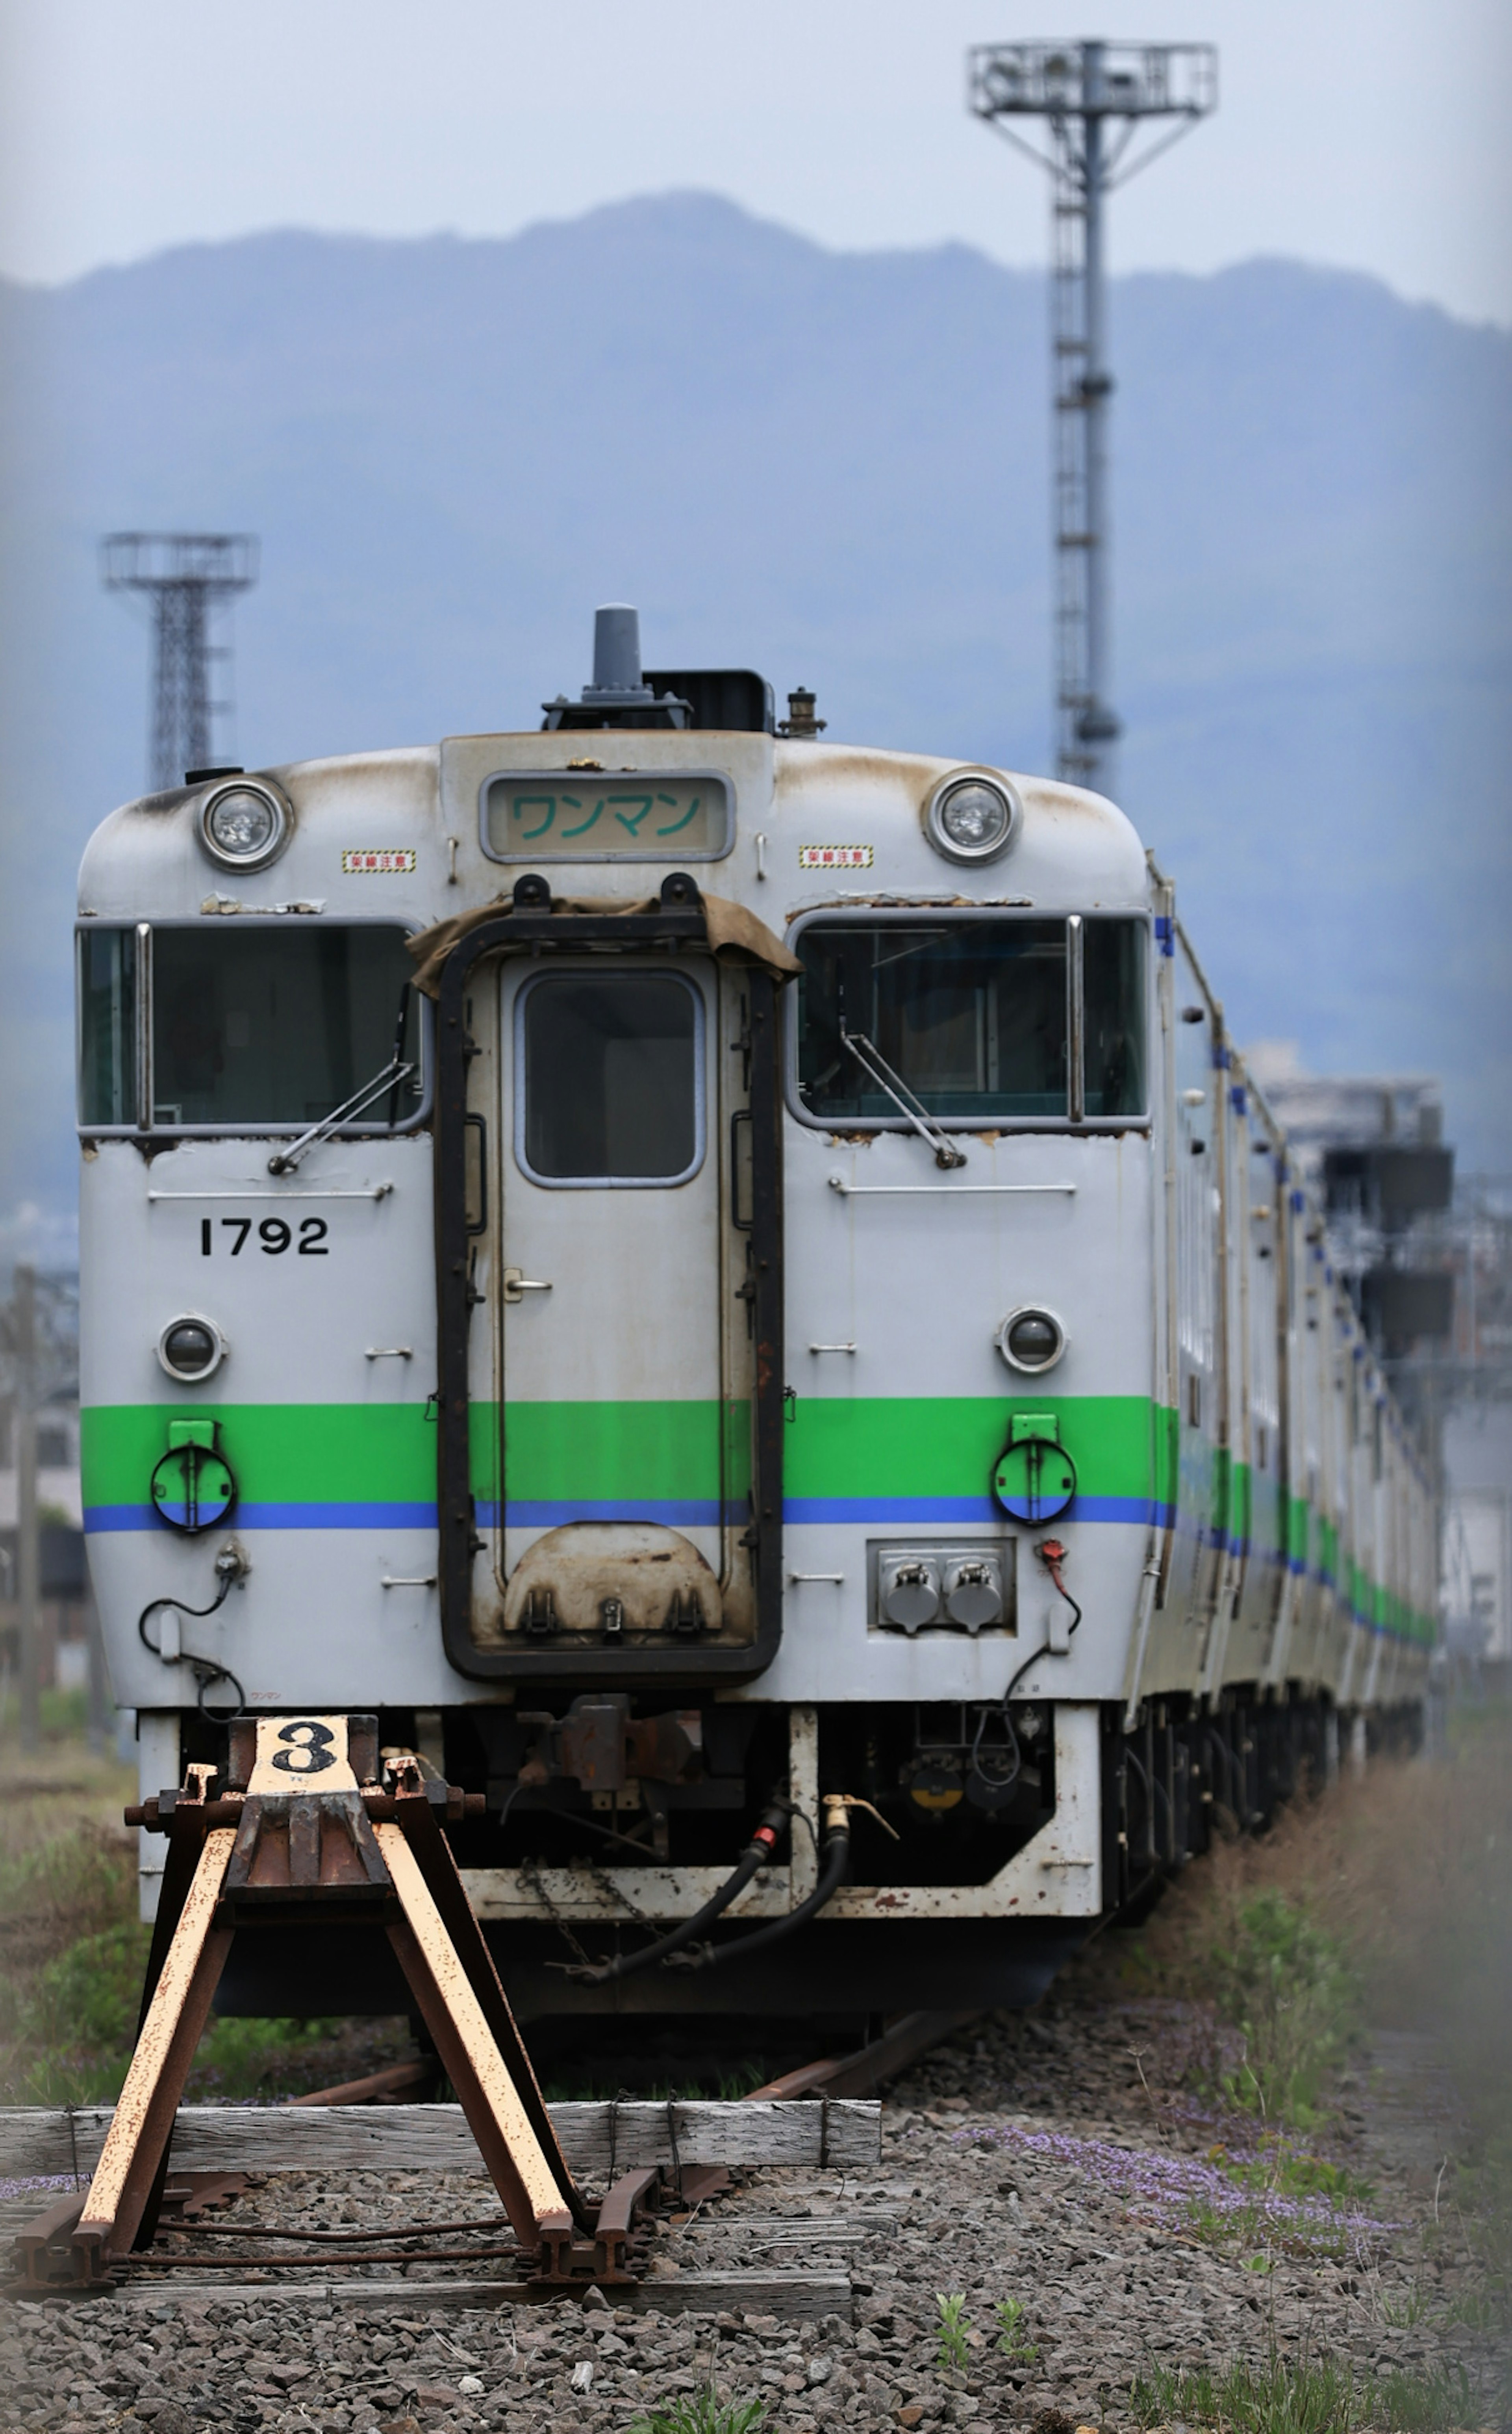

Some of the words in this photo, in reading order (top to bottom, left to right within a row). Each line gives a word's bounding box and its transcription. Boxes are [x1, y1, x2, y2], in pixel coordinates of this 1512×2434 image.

[513, 793, 700, 840] ワンマン
[352, 855, 406, 867] 架線注意
[808, 851, 863, 863] 架線注意
[202, 1217, 328, 1256] 1792
[251, 1692, 282, 1700] ワンマン
[272, 1721, 337, 1773] 3
